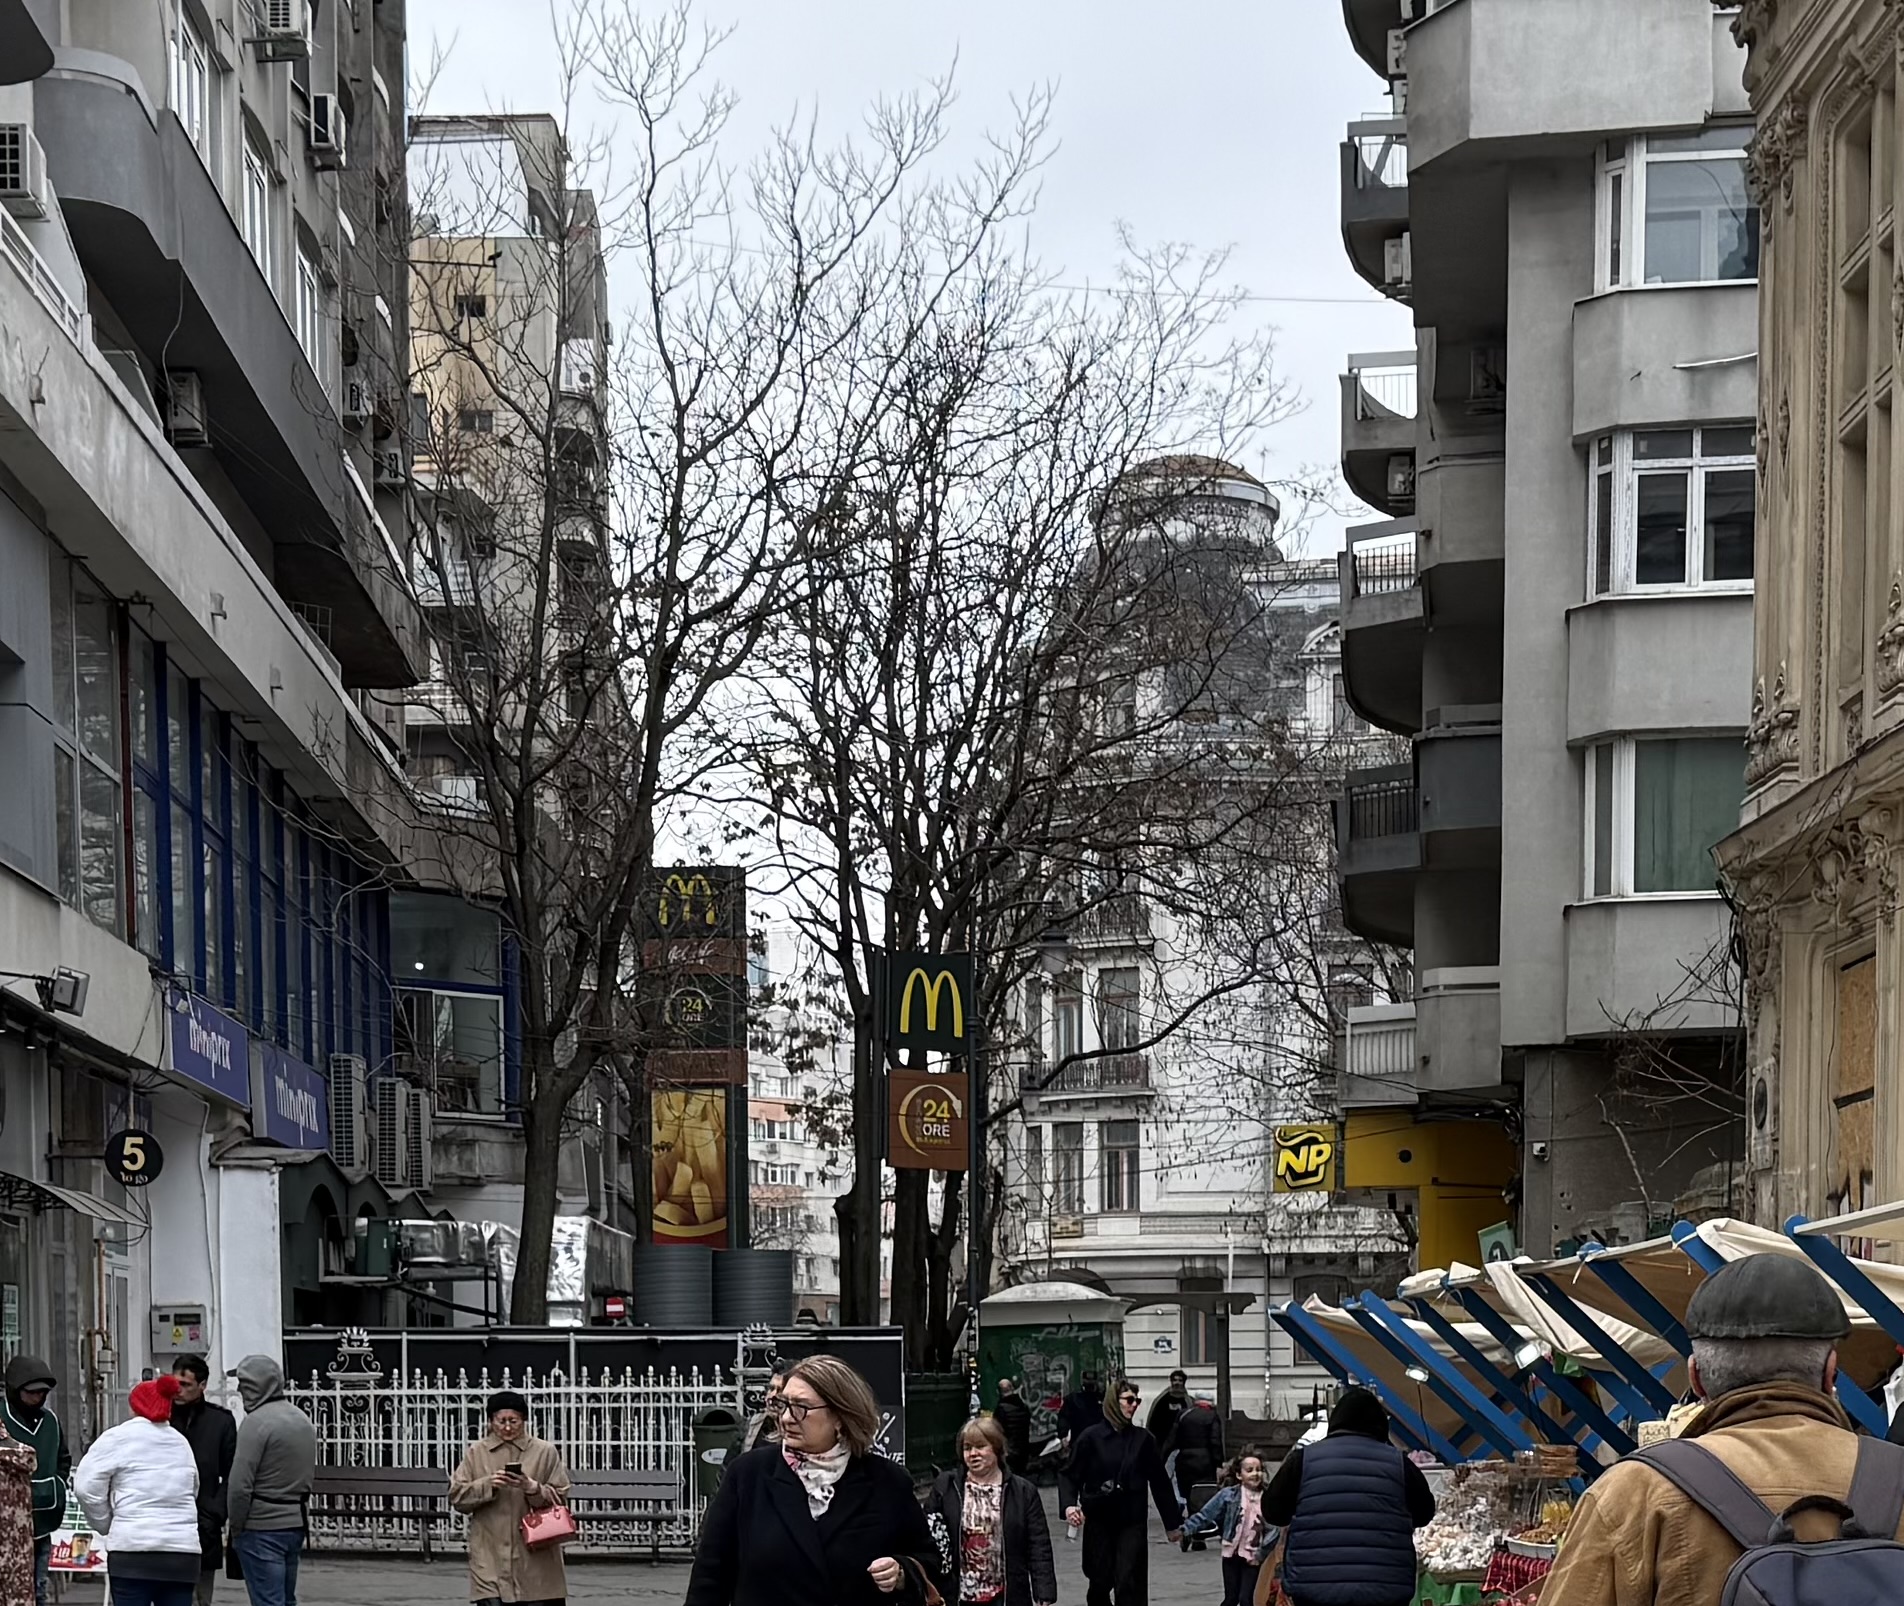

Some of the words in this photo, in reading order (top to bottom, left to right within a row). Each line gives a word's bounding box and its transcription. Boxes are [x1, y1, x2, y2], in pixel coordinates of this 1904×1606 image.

[923, 1099, 951, 1123] 24
[922, 1123, 950, 1137] ORE
[122, 1136, 146, 1171] 5
[1277, 1142, 1332, 1176] NP
